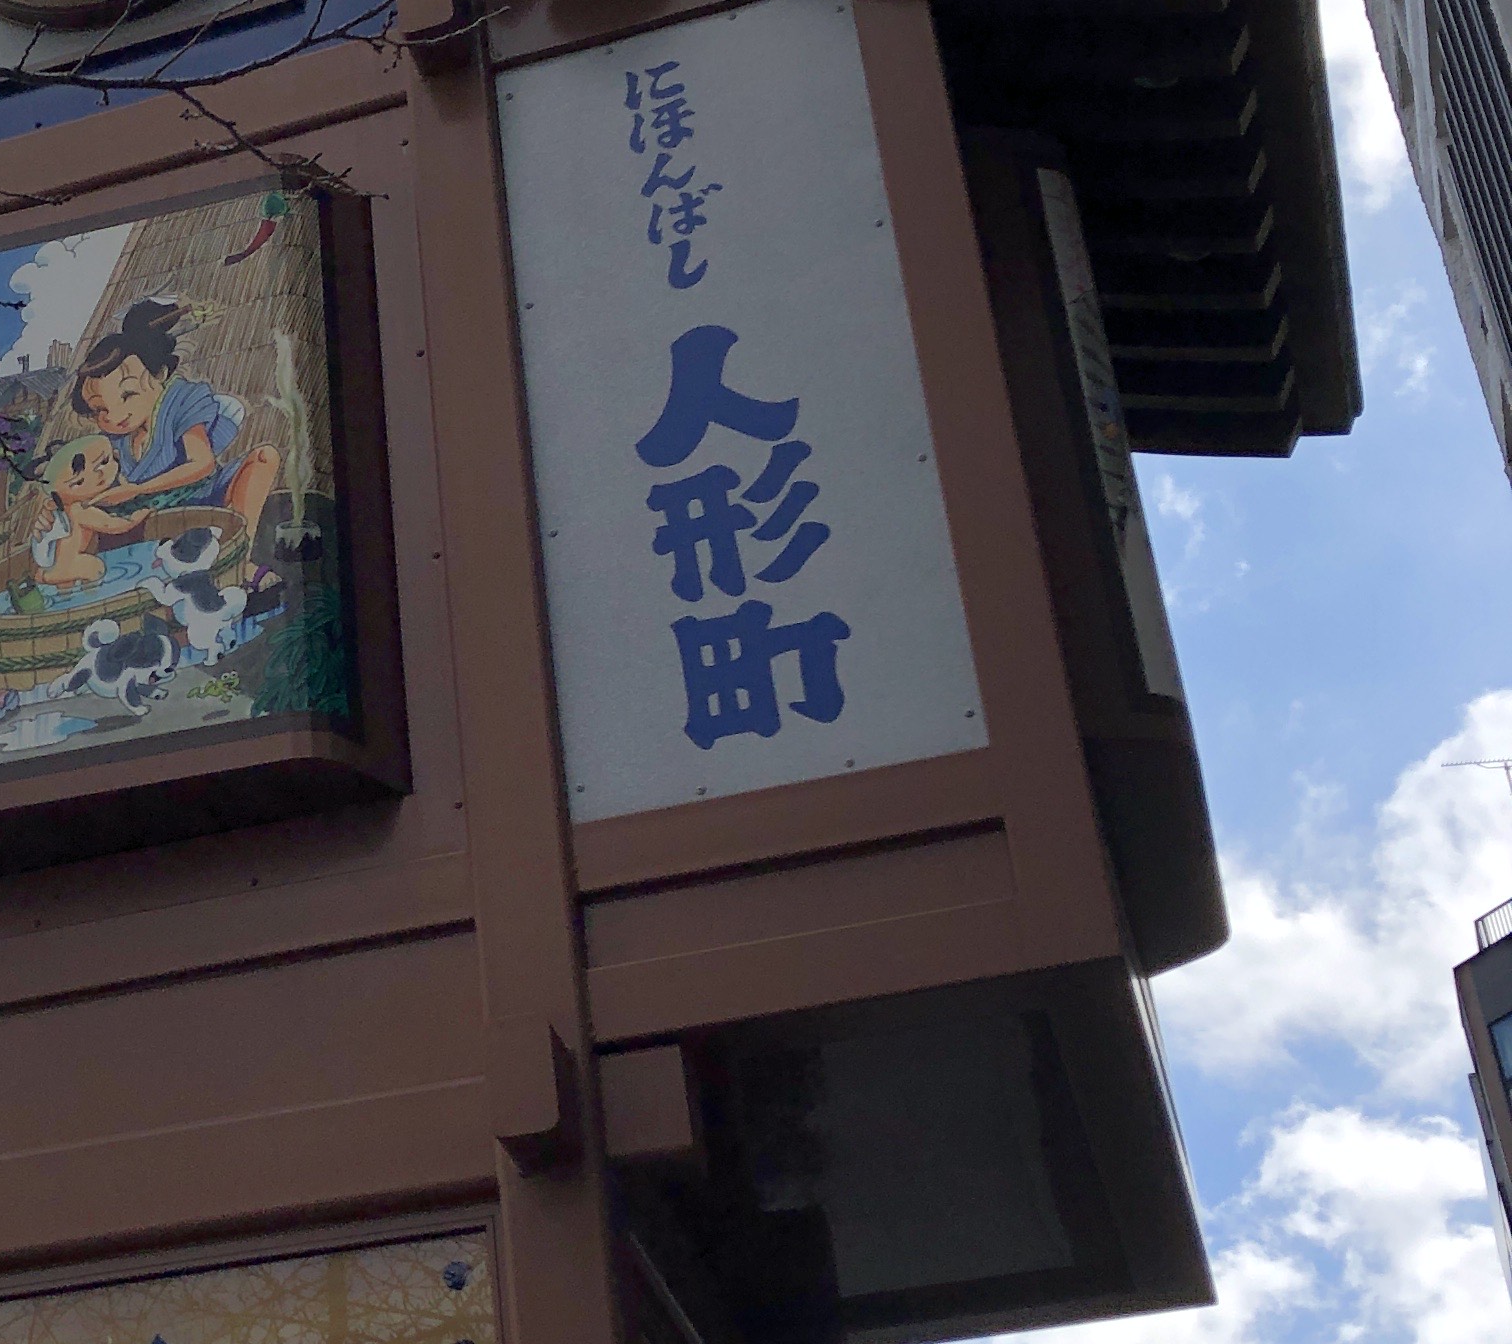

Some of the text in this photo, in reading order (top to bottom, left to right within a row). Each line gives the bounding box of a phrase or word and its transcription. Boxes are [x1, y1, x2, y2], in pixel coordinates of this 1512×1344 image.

[624, 60, 724, 290] にほんばし
[635, 324, 851, 749] 人形町
